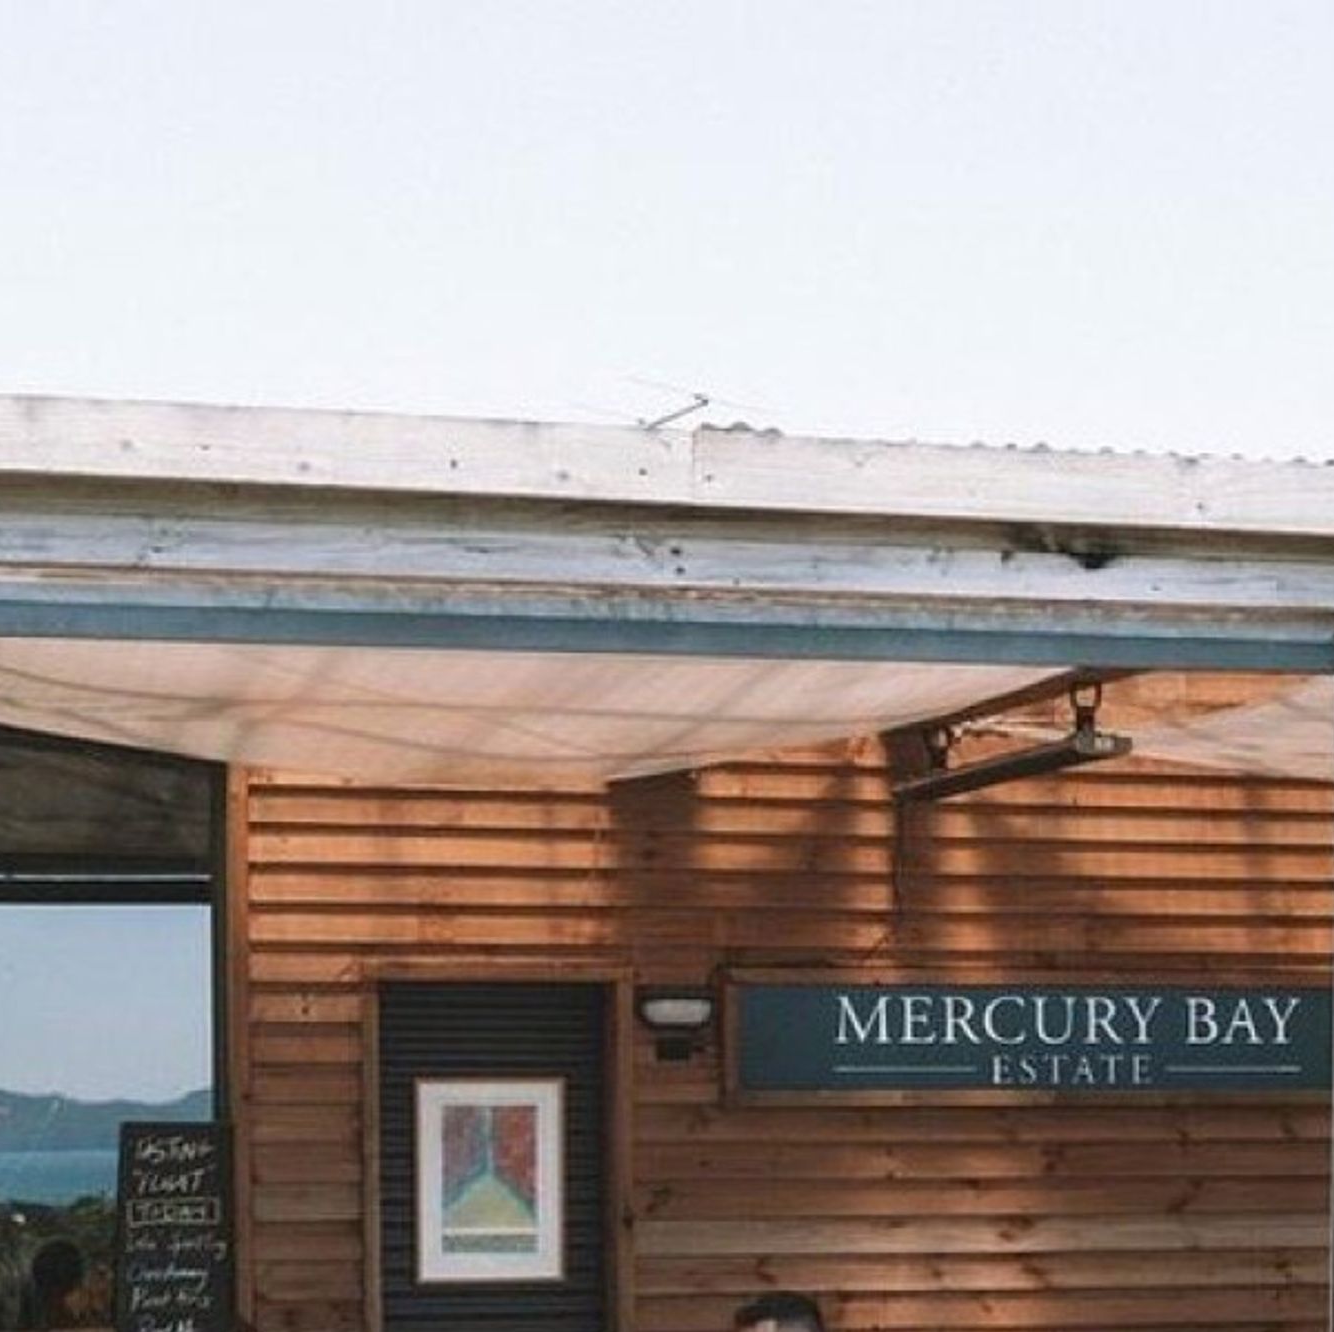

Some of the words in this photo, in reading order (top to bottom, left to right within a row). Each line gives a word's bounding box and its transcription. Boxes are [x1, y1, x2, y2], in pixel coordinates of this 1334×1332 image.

[834, 995, 1164, 1046] MERCURY
[1184, 996, 1301, 1046] BAY
[992, 1054, 1154, 1086] ESTATE
